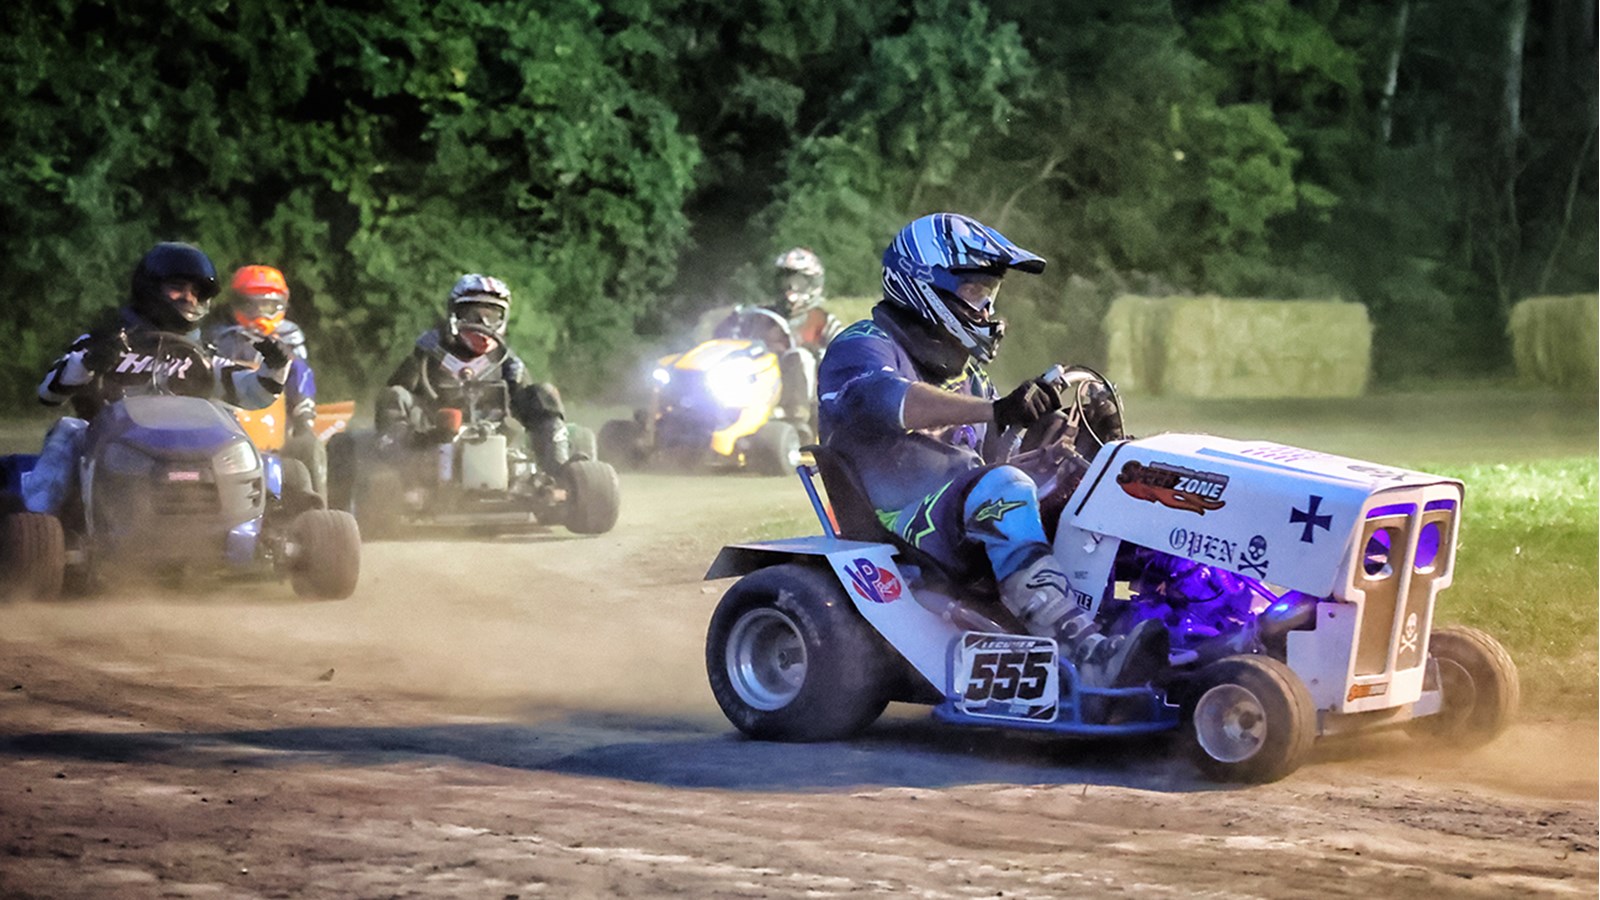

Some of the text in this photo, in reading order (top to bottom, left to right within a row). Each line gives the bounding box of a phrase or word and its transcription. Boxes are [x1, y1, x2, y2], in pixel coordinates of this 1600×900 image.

[1173, 476, 1223, 498] ZONE
[1169, 527, 1237, 564] OPEN
[843, 557, 884, 604] VP
[964, 652, 1054, 700] 555
